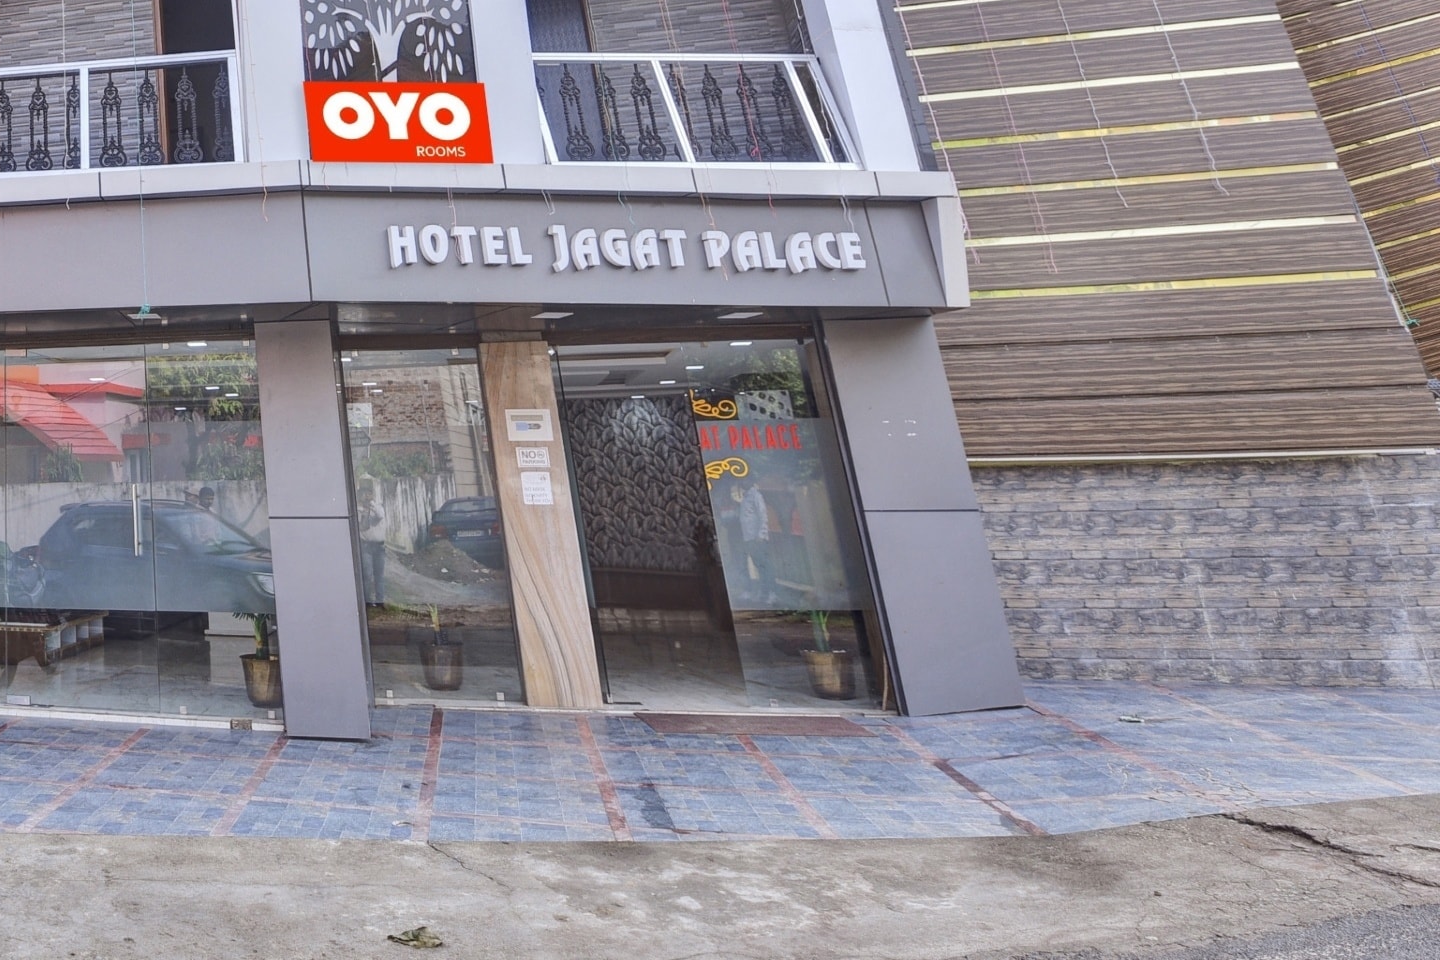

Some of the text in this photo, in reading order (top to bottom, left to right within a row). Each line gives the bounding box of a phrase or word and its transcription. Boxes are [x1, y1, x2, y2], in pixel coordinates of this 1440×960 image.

[322, 91, 471, 141] OYO
[416, 145, 466, 157] ROOMS
[388, 224, 866, 274] HOTEL JAGAT PALACE
[727, 423, 802, 451] PALACE
[521, 450, 537, 459] NO
